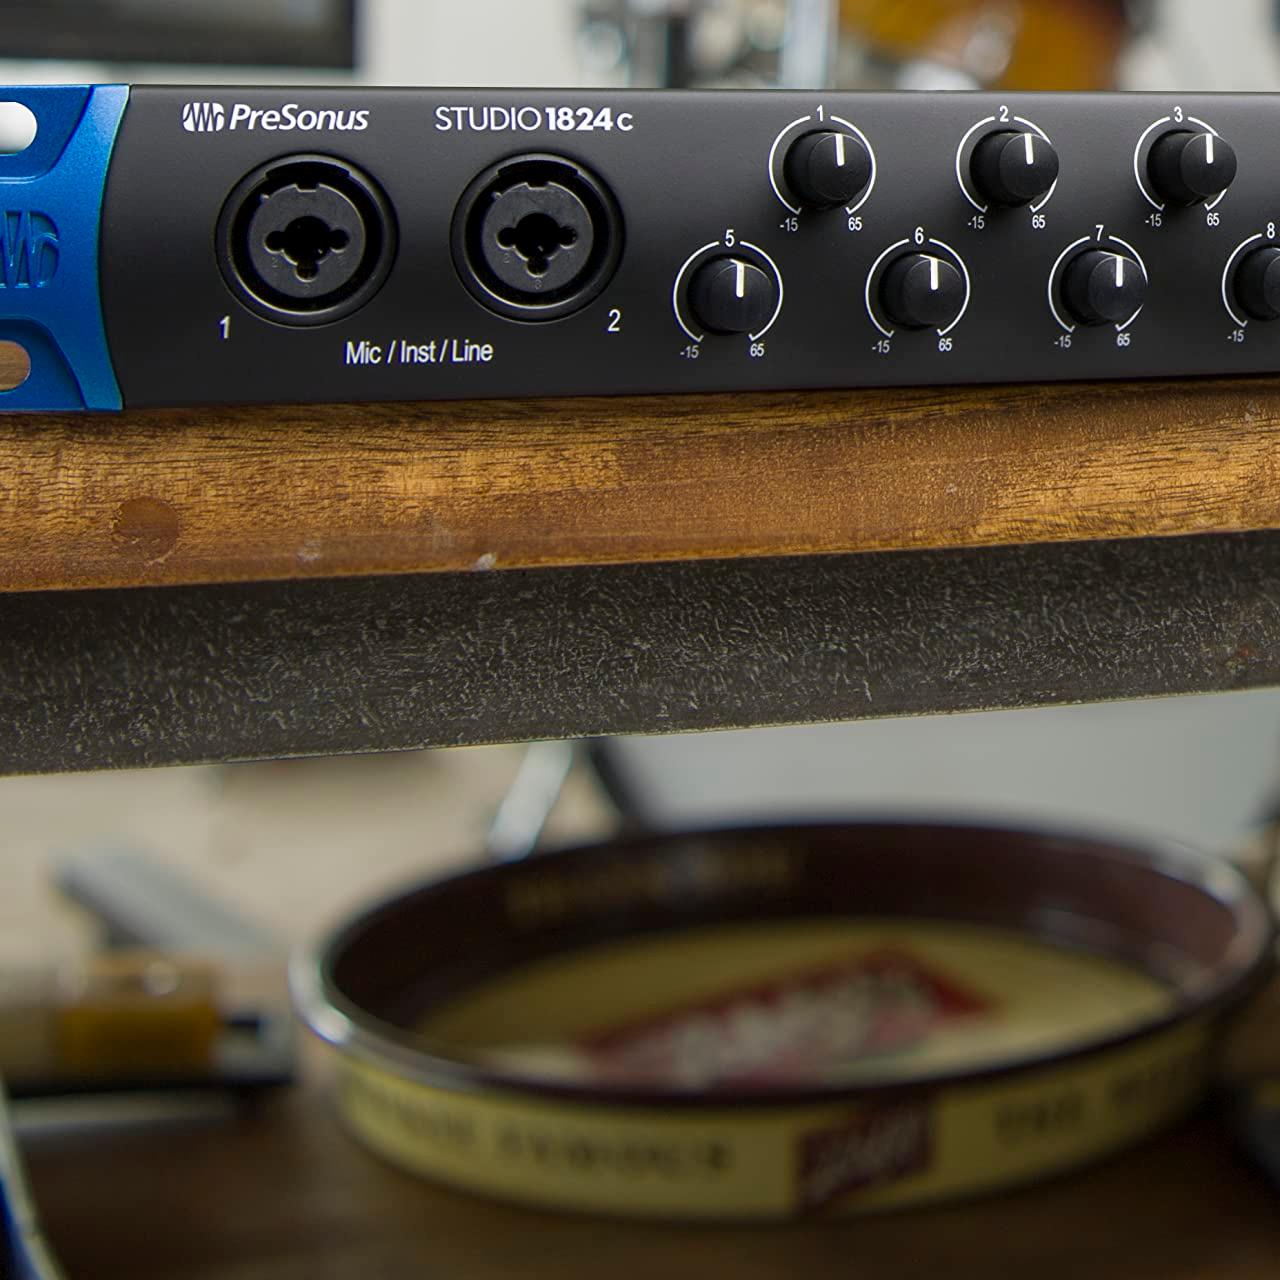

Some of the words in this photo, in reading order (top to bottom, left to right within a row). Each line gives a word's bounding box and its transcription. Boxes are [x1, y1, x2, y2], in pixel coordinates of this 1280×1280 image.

[230, 104, 369, 130] PreSonus
[436, 107, 541, 130] STUDIO
[817, 105, 823, 121] 1
[1000, 105, 1009, 122] 2
[1174, 106, 1183, 122] 3
[780, 218, 798, 231] -15
[849, 217, 862, 231] 65
[968, 216, 984, 229] -15
[1032, 211, 1045, 228] 65
[1145, 214, 1161, 226] -15
[1207, 213, 1219, 226] 65
[725, 229, 734, 247] 5
[915, 227, 923, 244] 6
[1096, 225, 1103, 241] 7
[1267, 222, 1275, 239] 8
[220, 316, 229, 338] 1
[608, 309, 620, 332] 2
[939, 334, 952, 351] 65
[1054, 335, 1071, 348] -15
[1117, 333, 1130, 346] 65
[1228, 330, 1244, 342] -15
[346, 341, 381, 364] Mic
[387, 341, 395, 363] /
[401, 341, 436, 363] Inst
[440, 339, 448, 362] /
[452, 340, 493, 362] Line
[680, 344, 700, 358] -15
[750, 339, 764, 356] 65
[872, 337, 890, 353] -15
